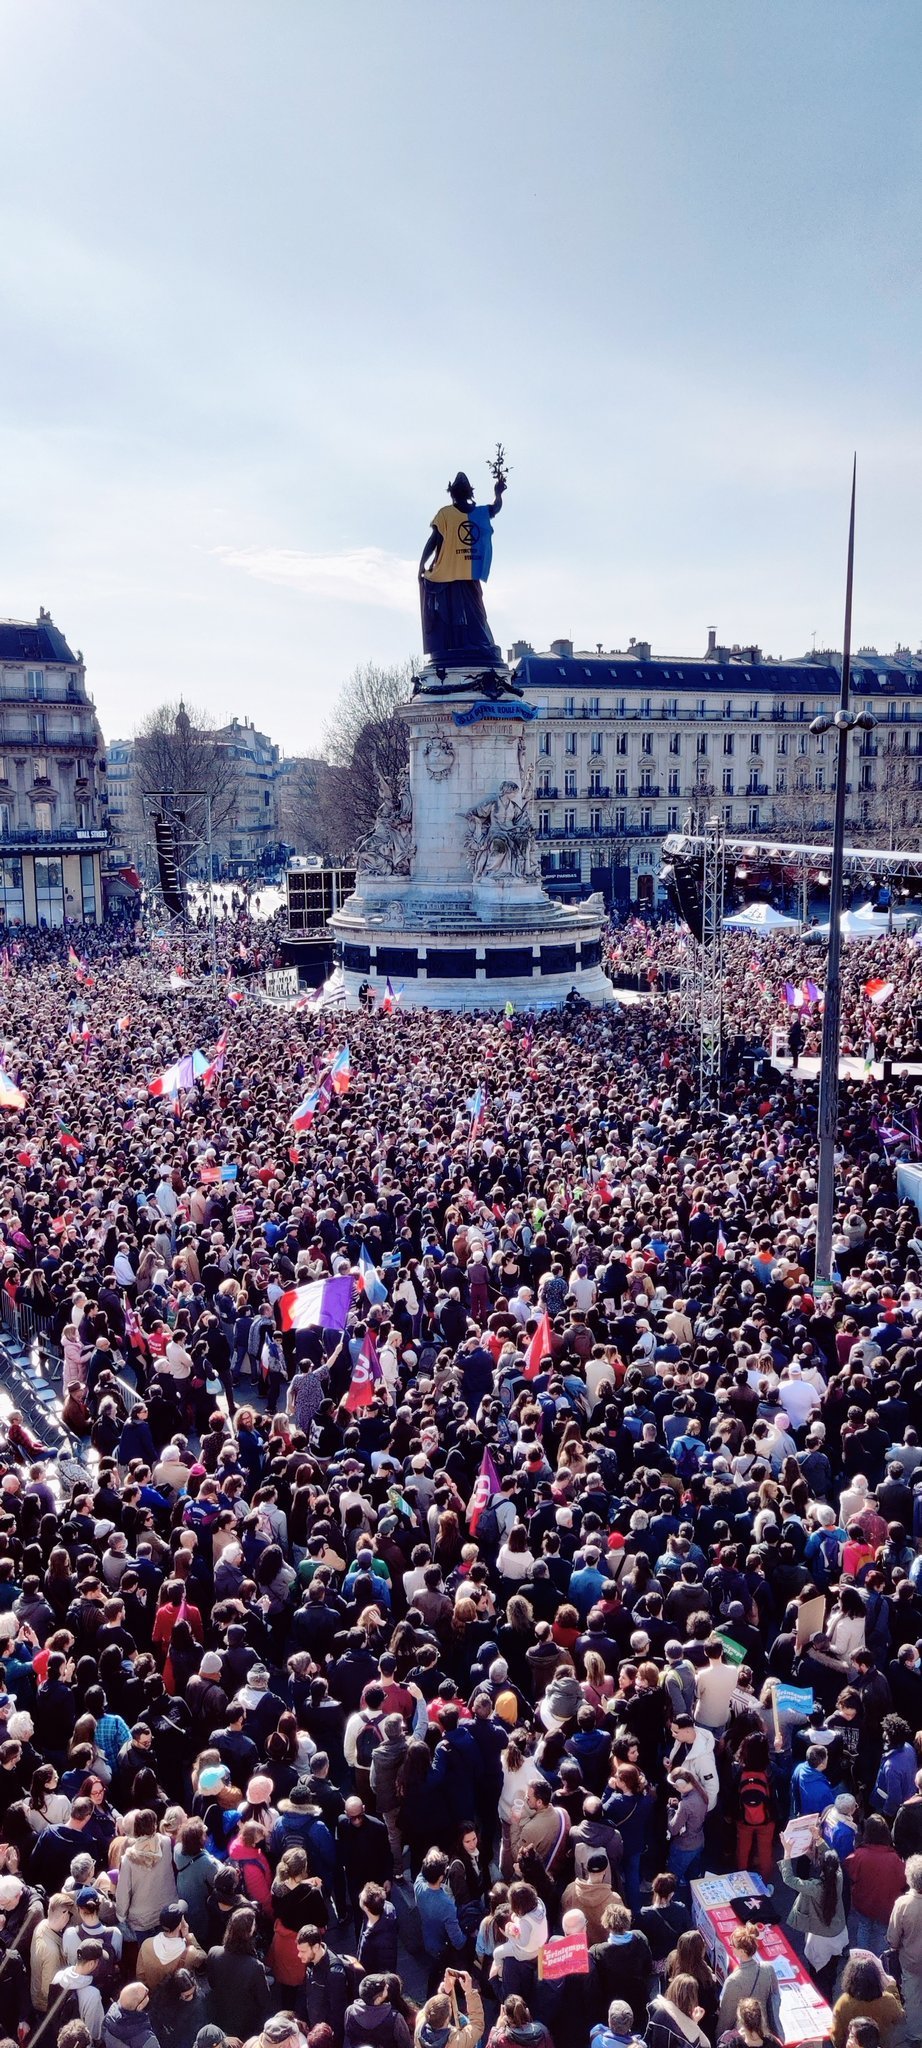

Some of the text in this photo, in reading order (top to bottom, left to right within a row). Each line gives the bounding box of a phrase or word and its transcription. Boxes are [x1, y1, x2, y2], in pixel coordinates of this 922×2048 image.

[498, 706, 515, 714] ROULE
[76, 830, 108, 838] WALL STREET
[546, 1944, 586, 1960] printemps
[548, 1952, 573, 1966] peuple
